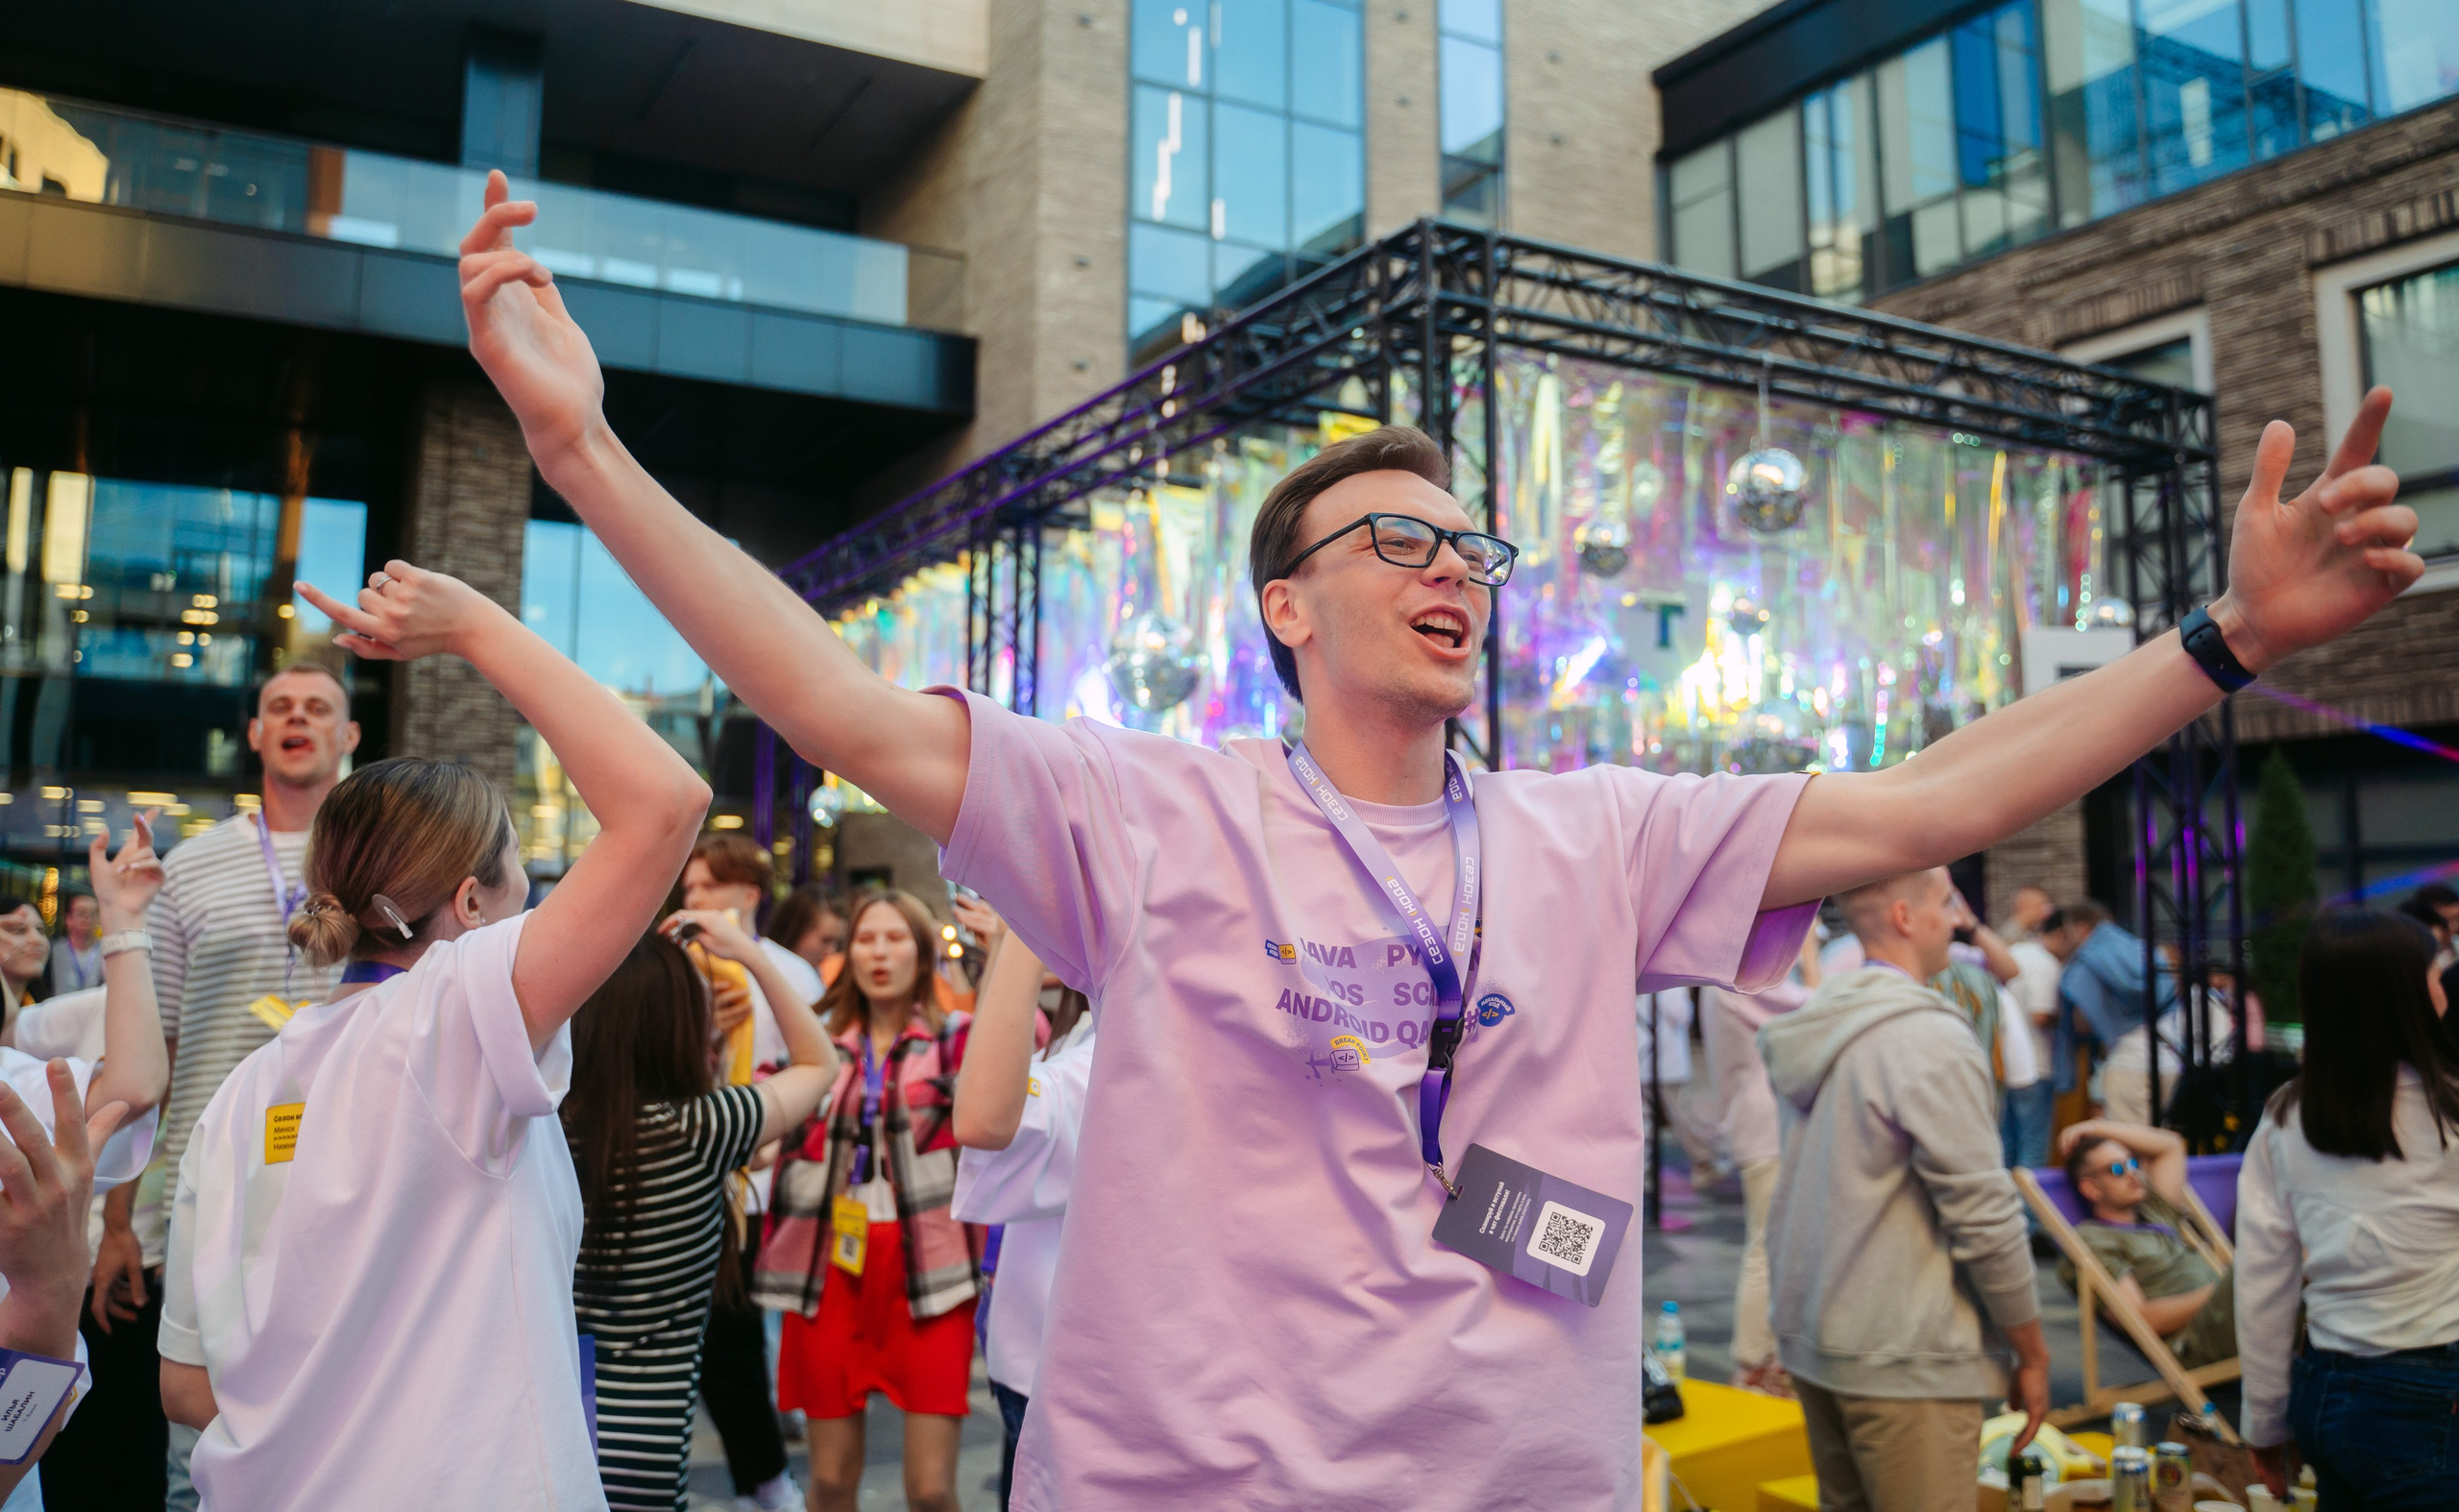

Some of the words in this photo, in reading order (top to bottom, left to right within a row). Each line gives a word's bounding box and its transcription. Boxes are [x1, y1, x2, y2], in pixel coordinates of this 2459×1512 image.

[1276, 988, 1389, 1043] ANDROID
[1334, 1036, 1355, 1047] BREAK
[1355, 1041, 1370, 1062] POINT
[1, 1399, 20, 1421] ИЛЬЯ
[5, 1391, 36, 1432] ШАБАЛИН
